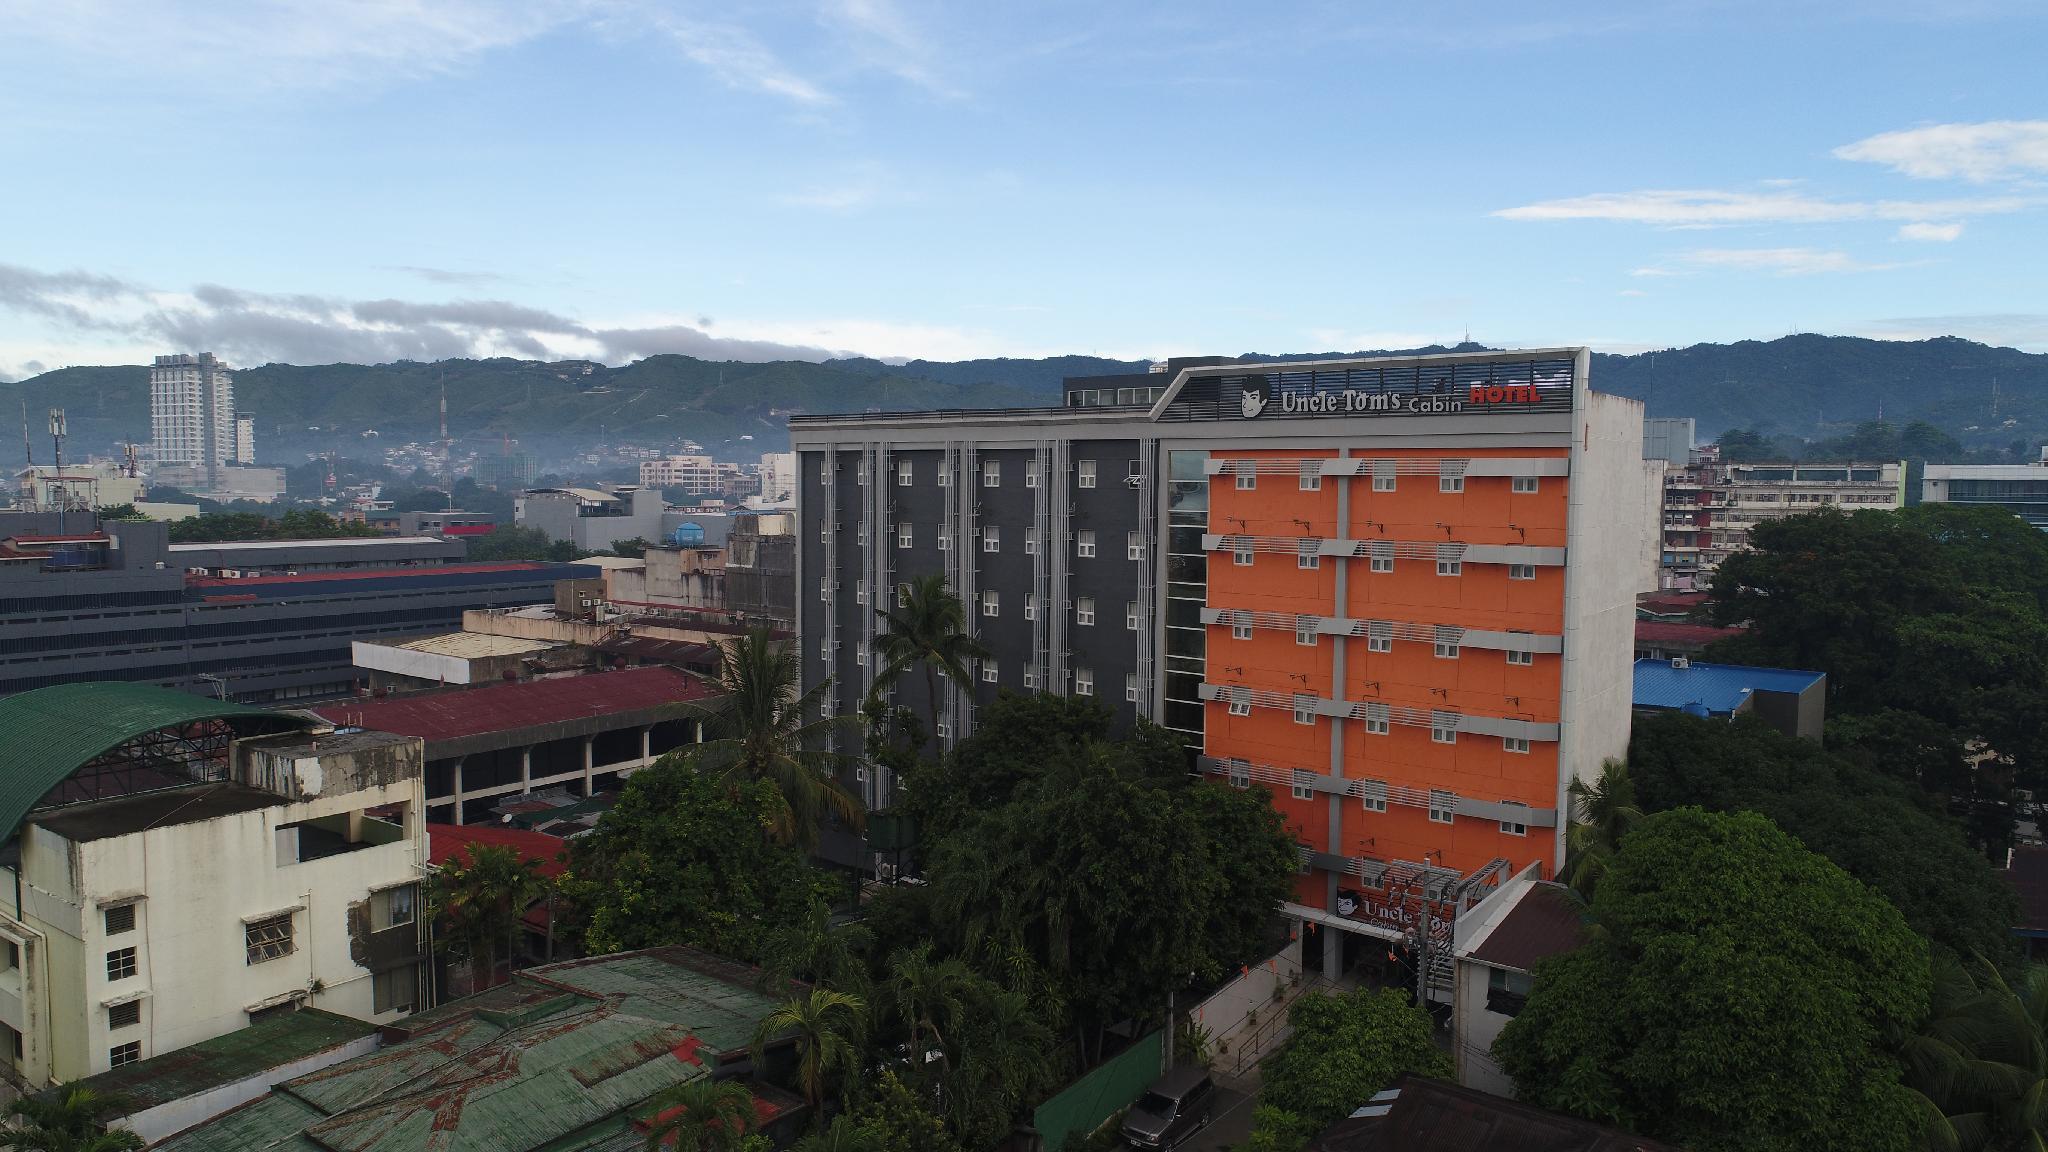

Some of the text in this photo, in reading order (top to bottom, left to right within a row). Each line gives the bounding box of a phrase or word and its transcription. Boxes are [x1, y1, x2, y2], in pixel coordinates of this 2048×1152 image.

[1281, 385, 1541, 412] Uncle Tom's Cabin HOTEL
[1365, 900, 1413, 924] Uncle
